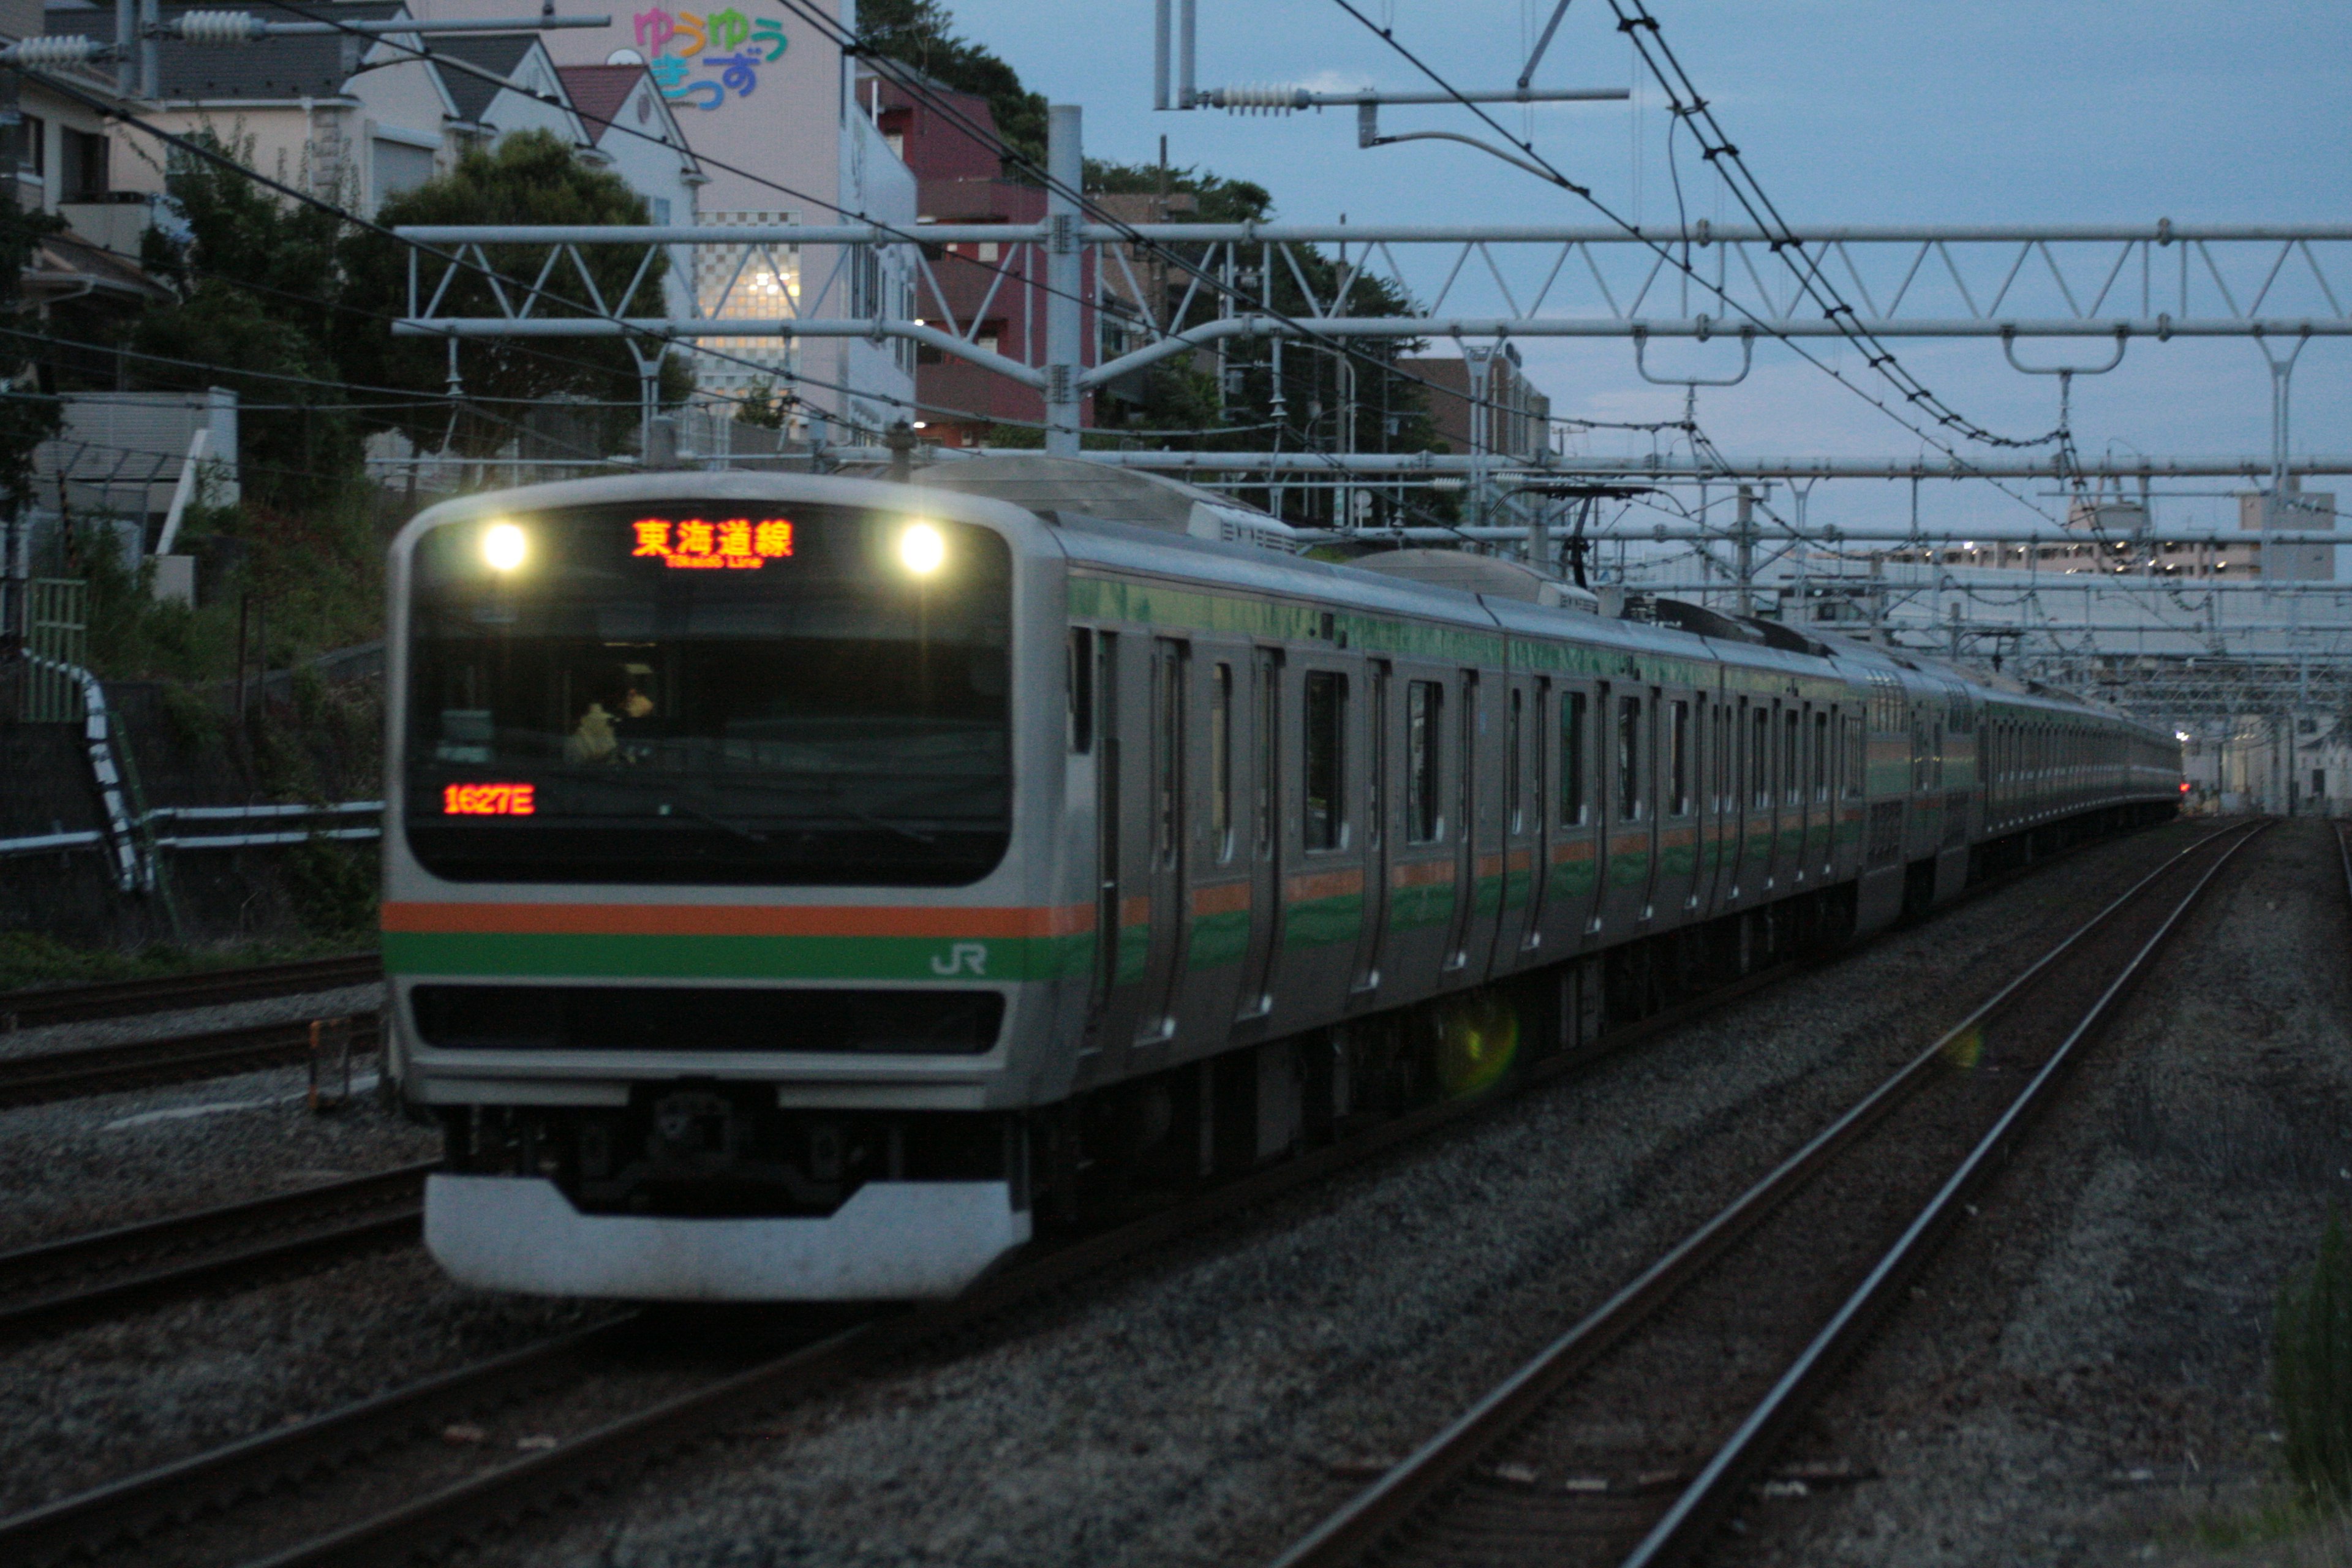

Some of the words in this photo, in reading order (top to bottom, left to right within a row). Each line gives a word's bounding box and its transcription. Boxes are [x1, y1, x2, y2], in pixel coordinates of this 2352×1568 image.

[633, 7, 788, 62] ゆうゆう
[633, 519, 793, 556] 東海道線
[444, 784, 535, 815] 1627E
[932, 943, 986, 975] JR
